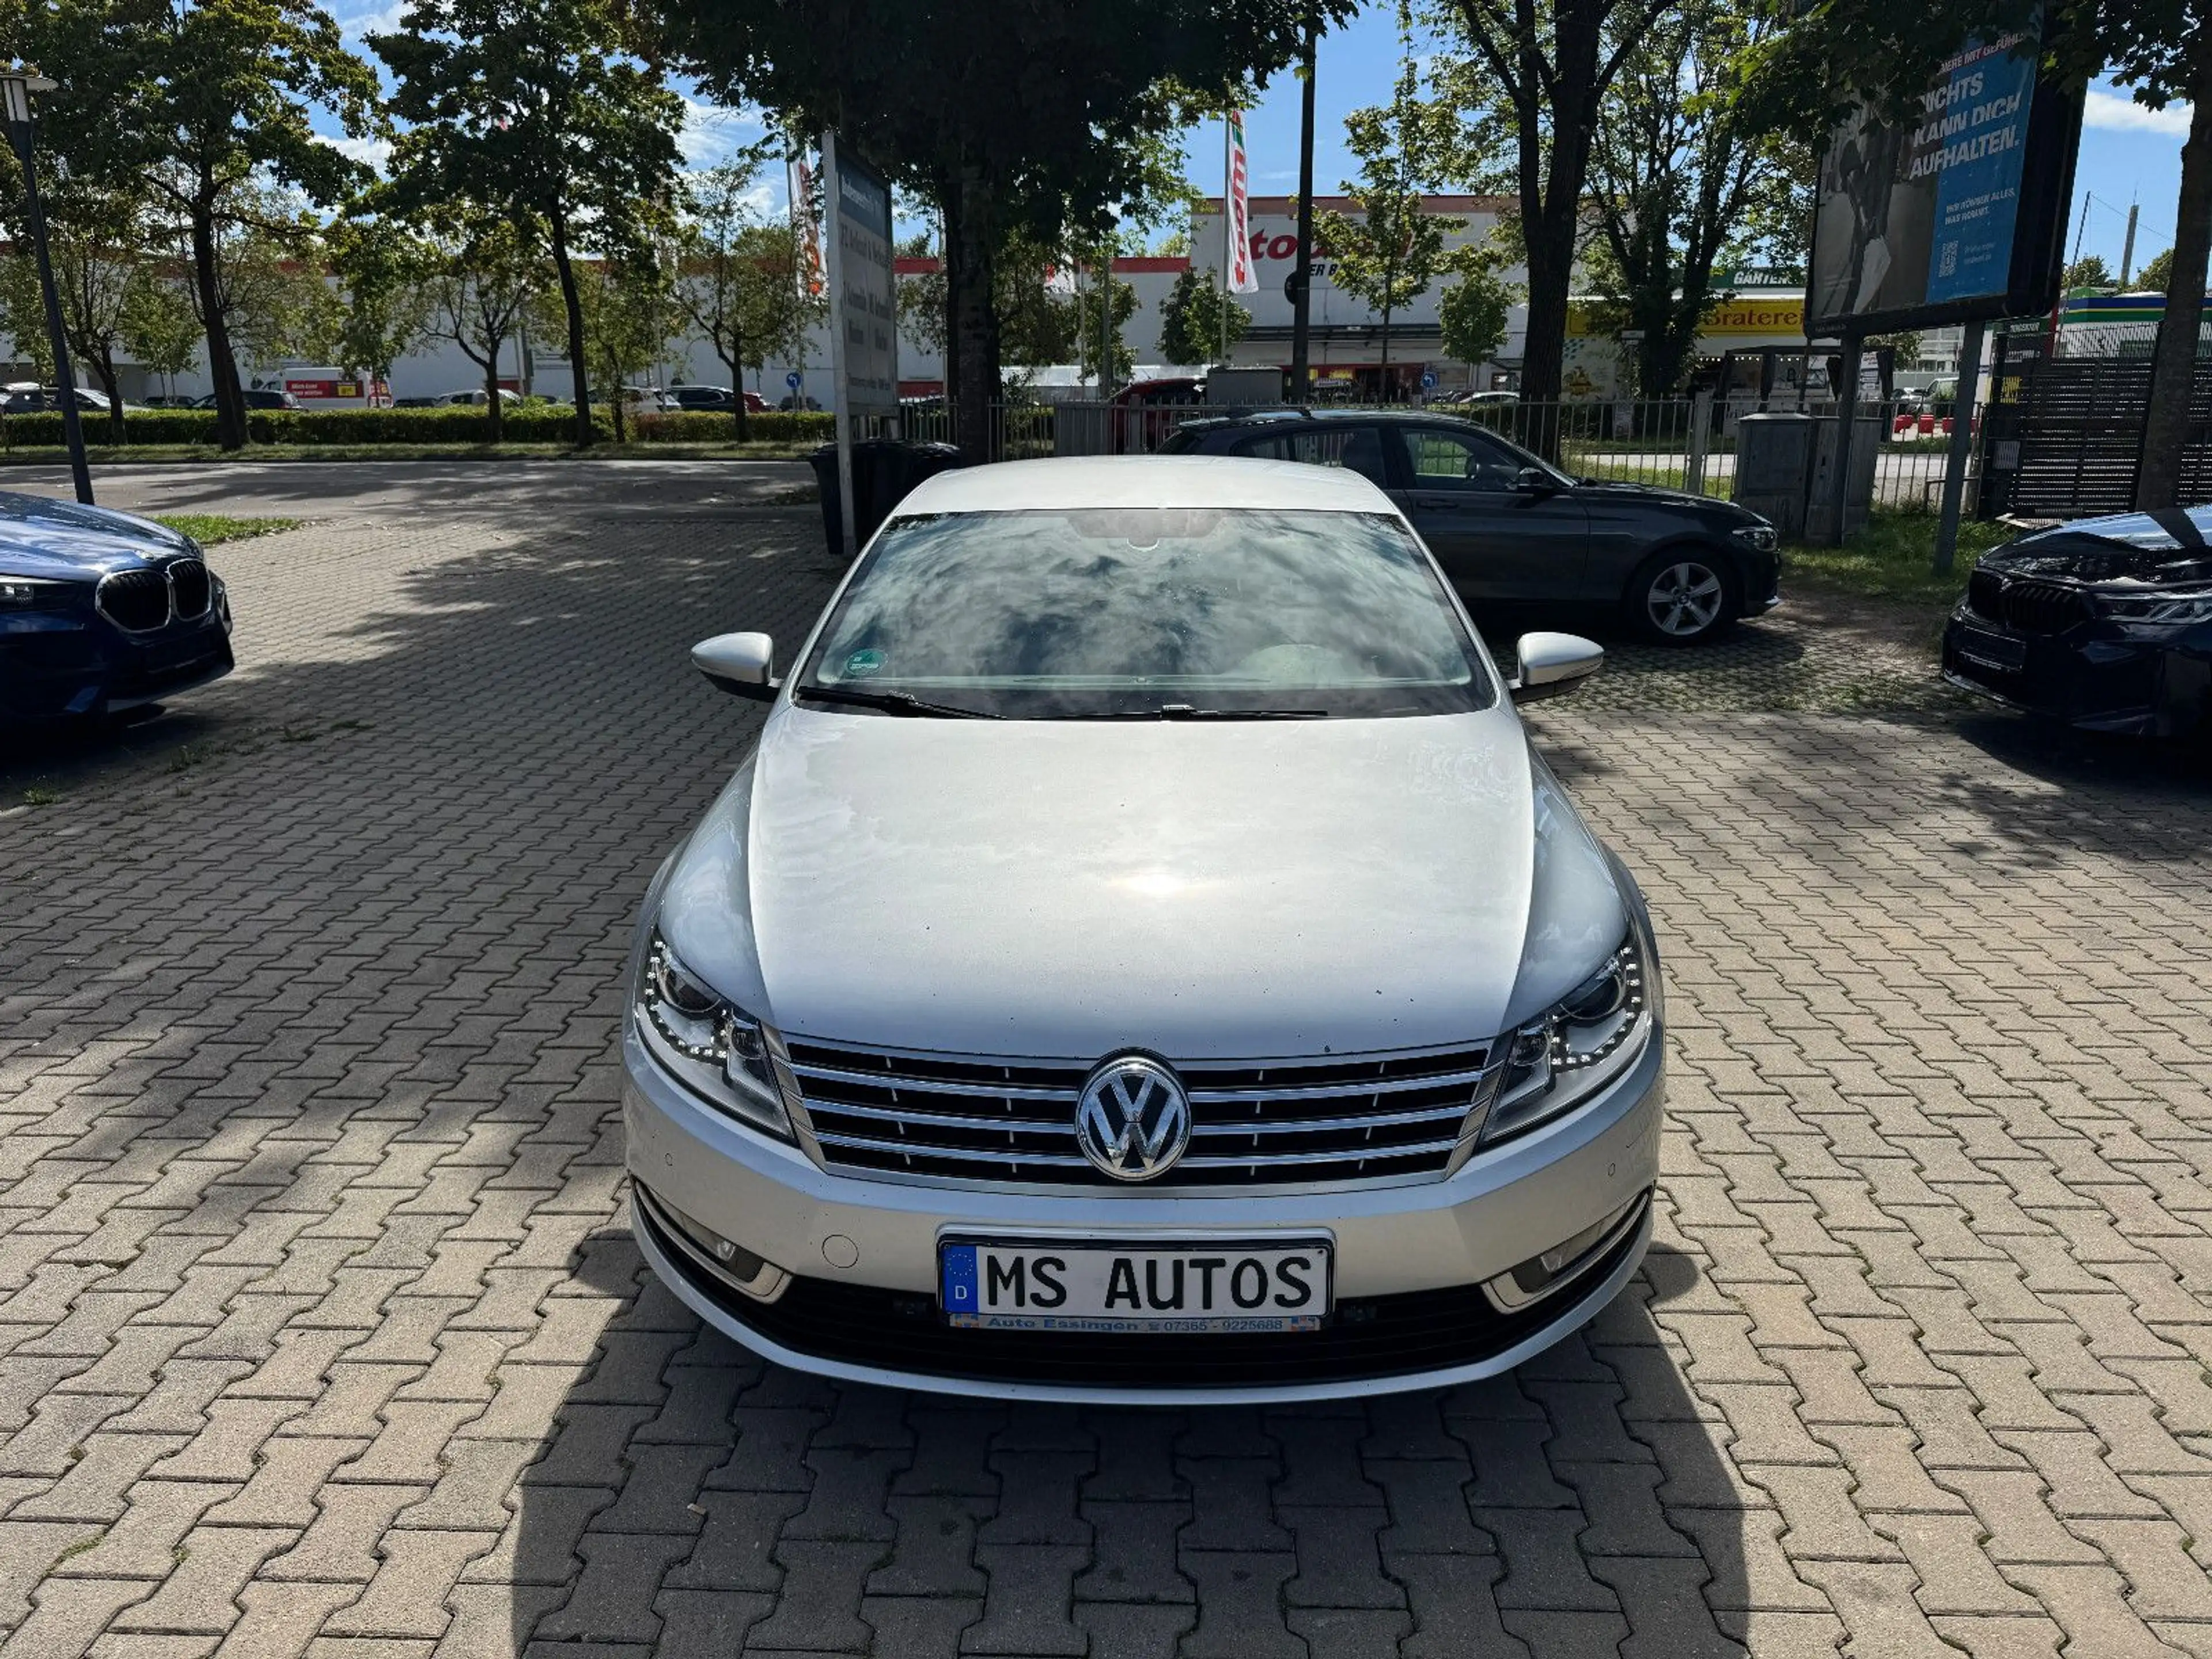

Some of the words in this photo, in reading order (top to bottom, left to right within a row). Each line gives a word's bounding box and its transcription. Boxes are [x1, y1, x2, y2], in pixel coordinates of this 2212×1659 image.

[1913, 111, 1968, 147] KANN
[1971, 93, 2021, 127] DICH
[1909, 124, 2020, 181] AUFHALTEN.
[955, 1285, 967, 1300] D
[987, 1255, 1067, 1308] MS
[1104, 1256, 1312, 1310] AUTOS
[987, 1317, 1035, 1328] Auto
[1044, 1319, 1138, 1331] Essingen
